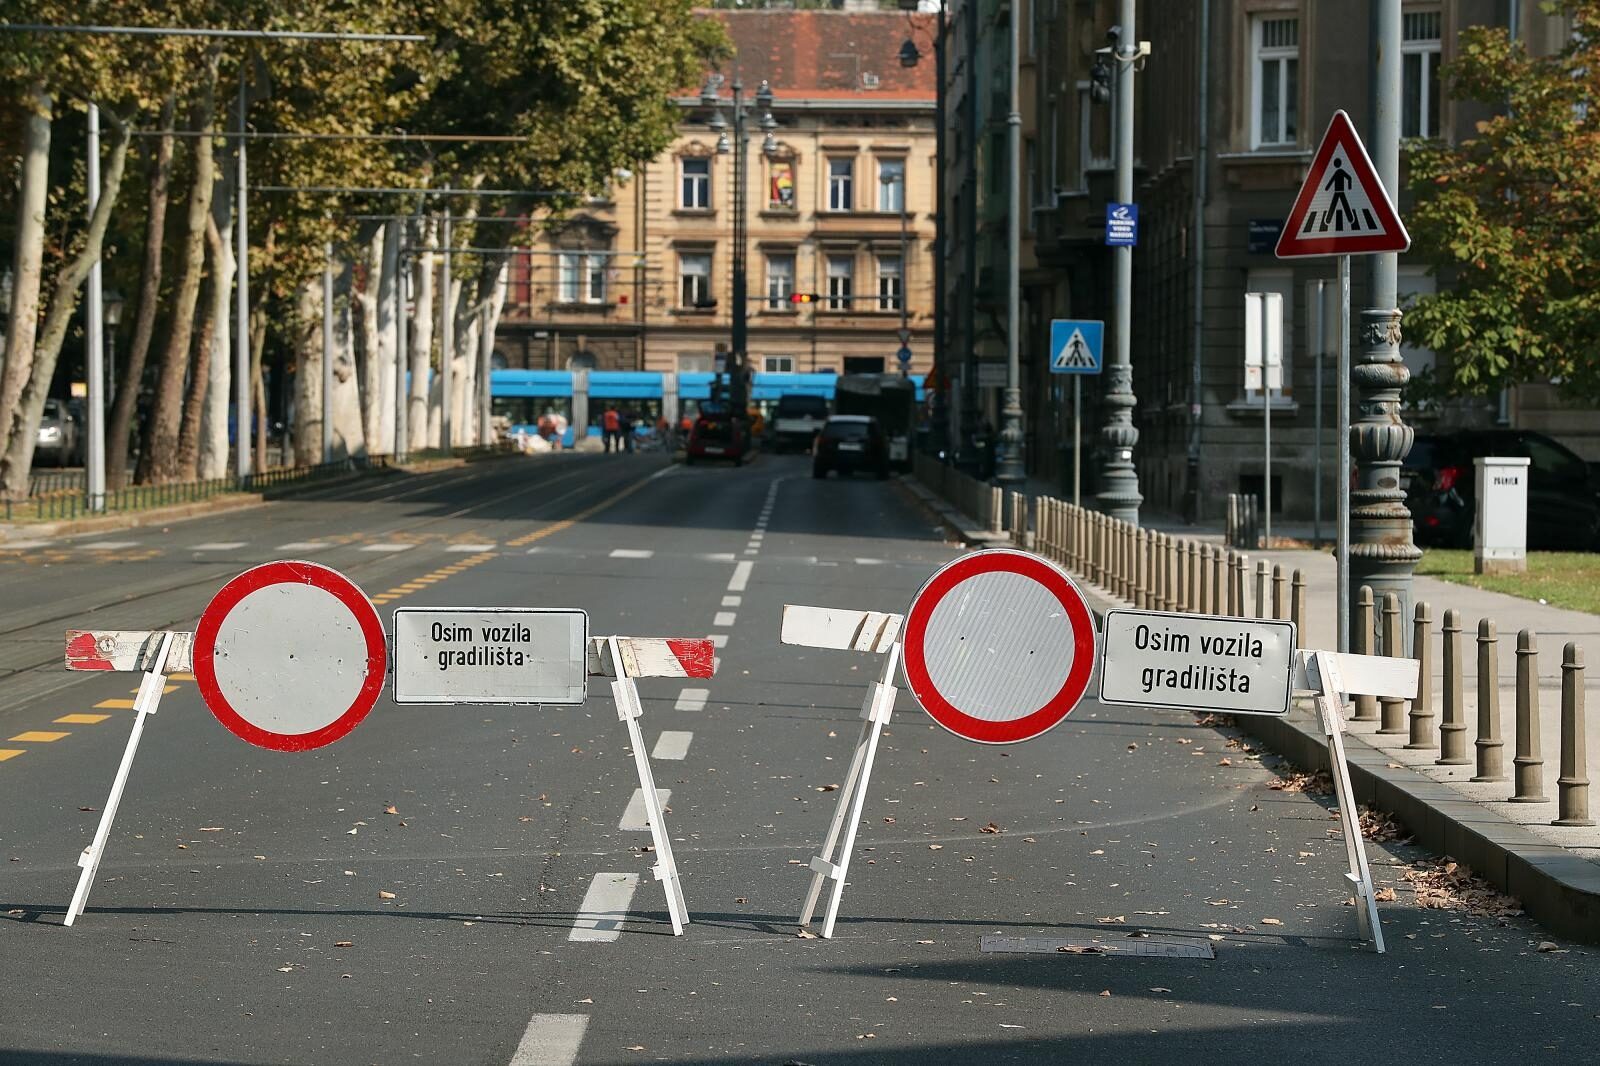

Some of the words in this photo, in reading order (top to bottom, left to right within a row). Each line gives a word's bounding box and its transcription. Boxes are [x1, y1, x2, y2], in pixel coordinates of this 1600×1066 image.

[431, 621, 473, 643] Osim
[481, 622, 531, 643] vozila
[1134, 624, 1190, 653] Osim
[1200, 632, 1263, 658] vozila
[438, 646, 524, 671] gradilišta
[1141, 665, 1250, 694] gradilišta
